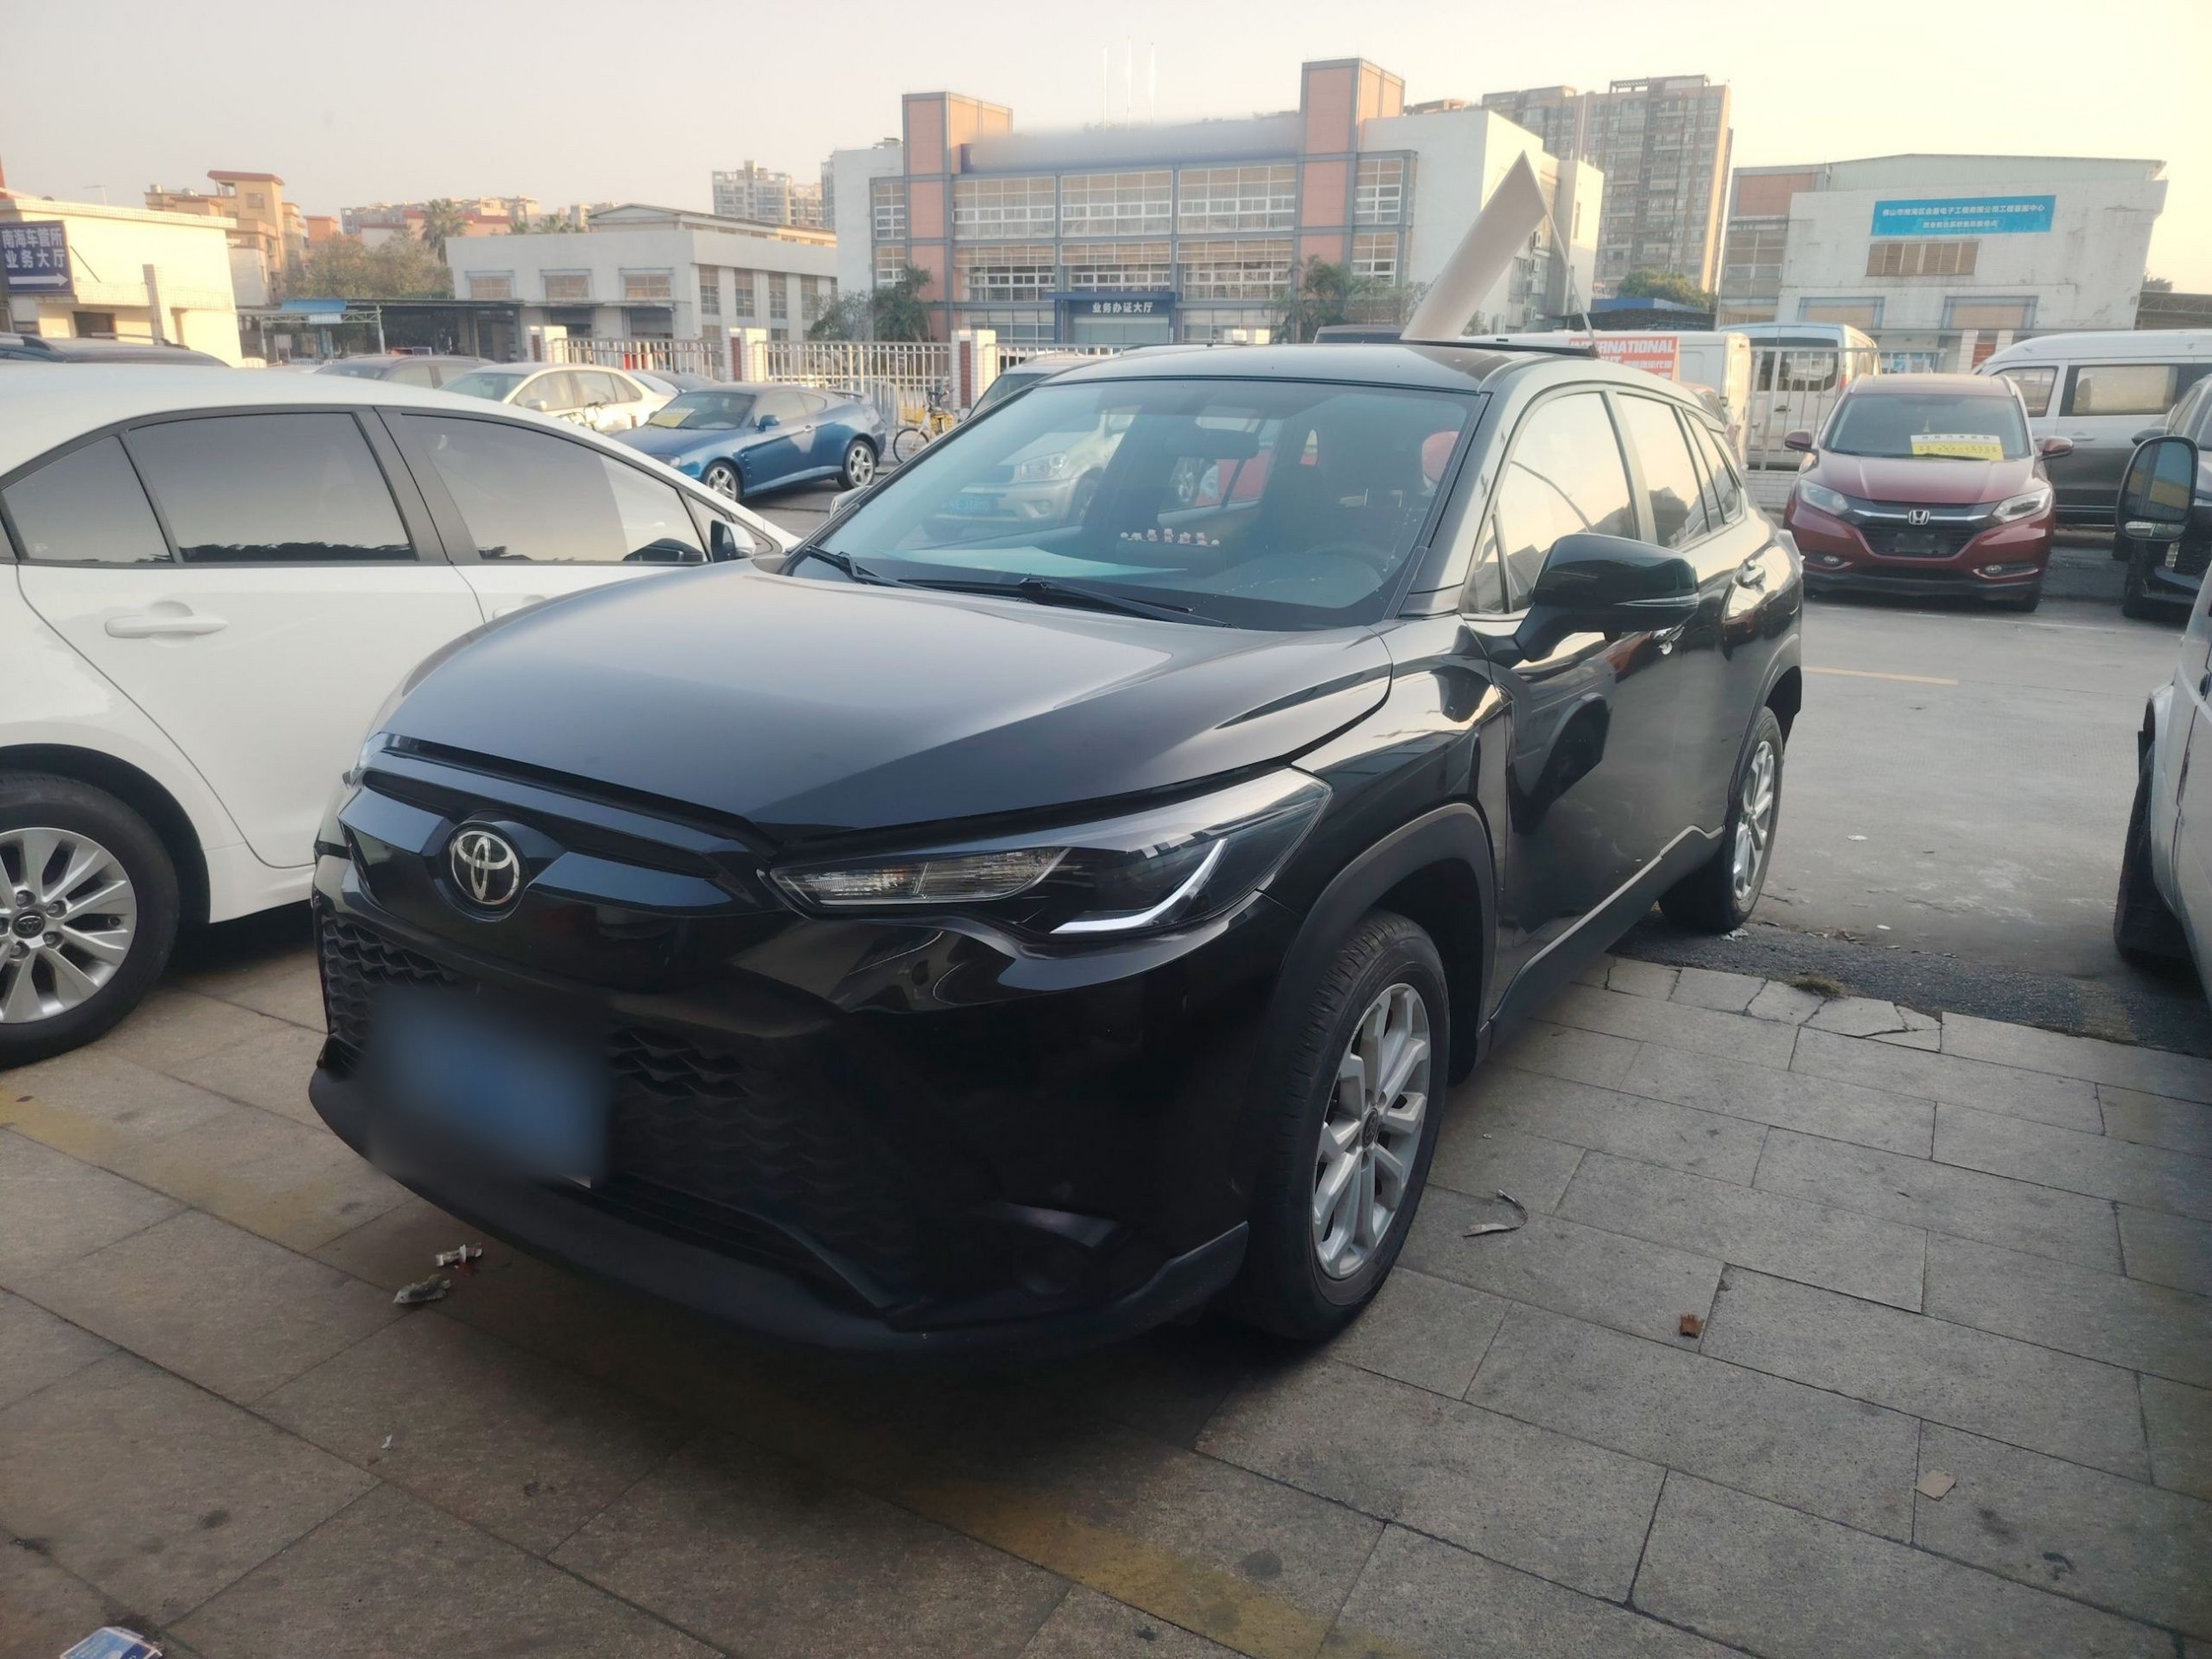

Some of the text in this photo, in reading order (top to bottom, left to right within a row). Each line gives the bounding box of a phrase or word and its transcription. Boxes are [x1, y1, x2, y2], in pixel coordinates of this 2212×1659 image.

[1, 228, 63, 248] 南海车管所
[5, 249, 65, 268] 业务大厅
[1092, 302, 1153, 314] 业务办证大厅
[1571, 340, 1674, 354] RNATIONAL
